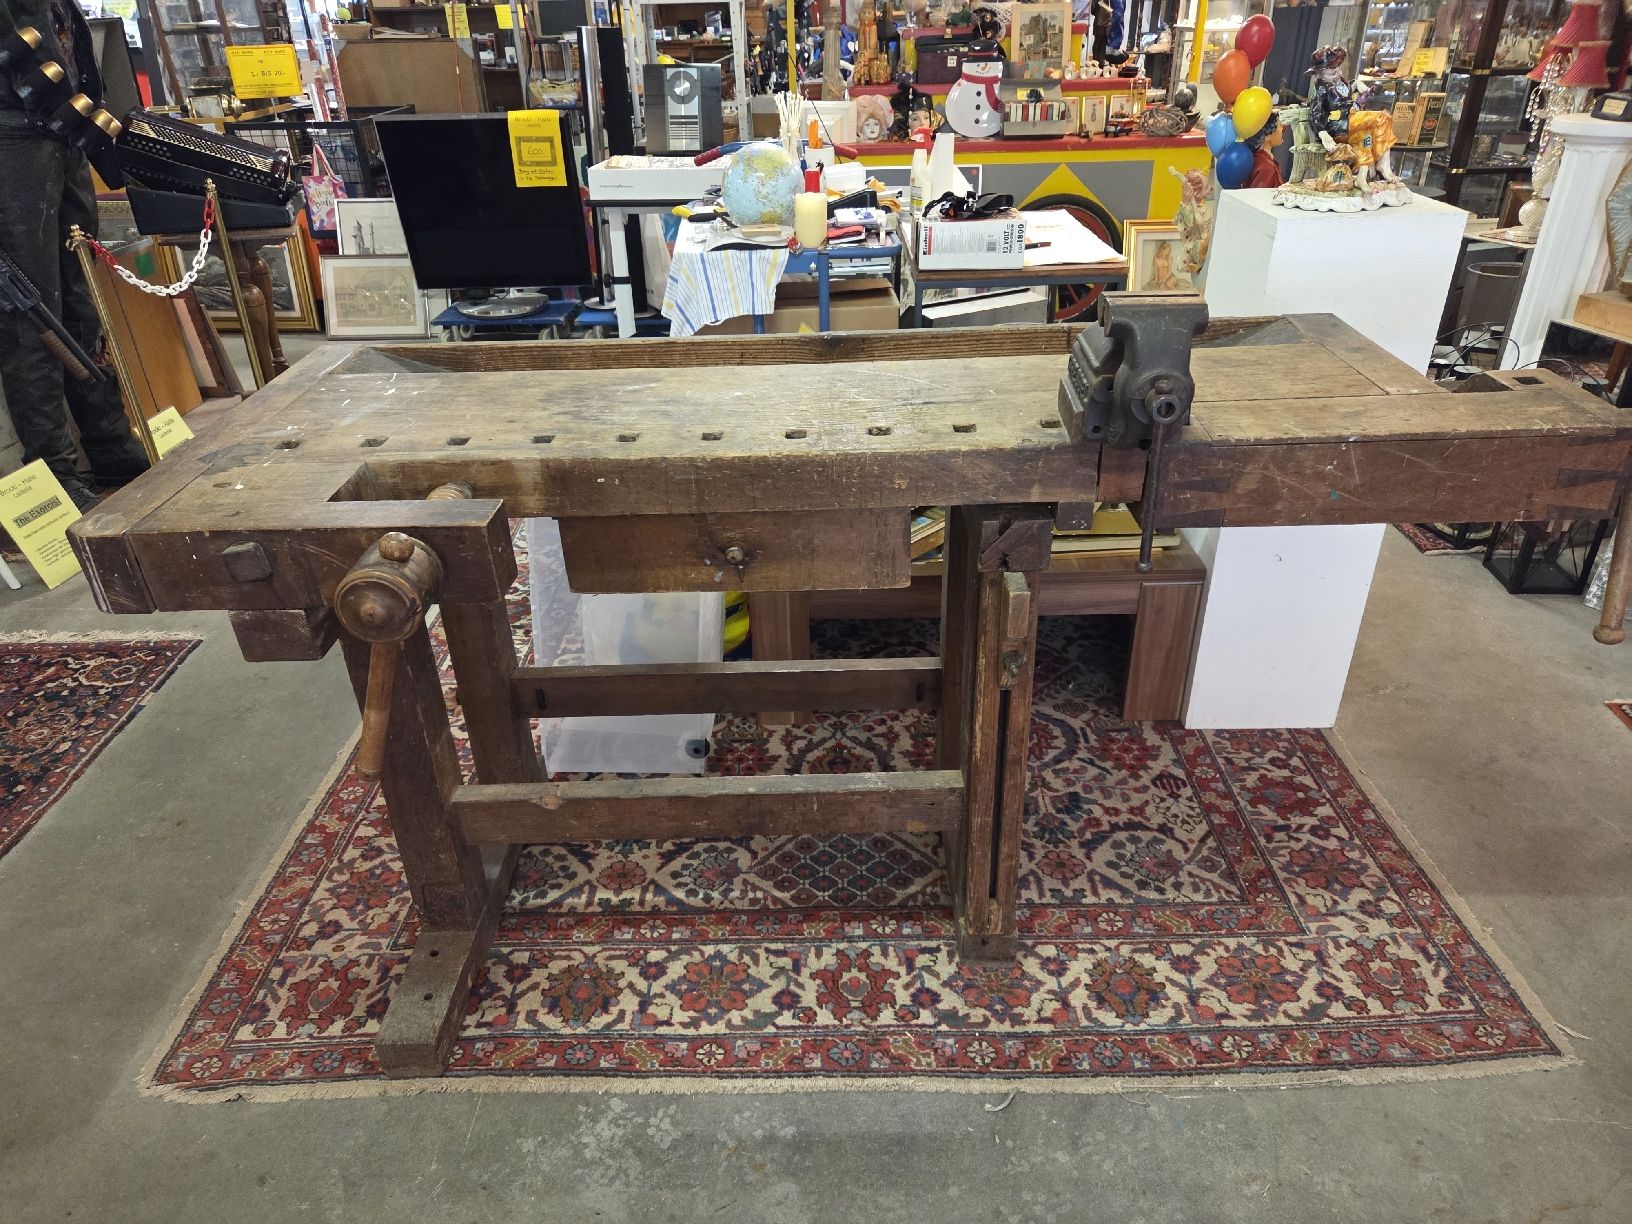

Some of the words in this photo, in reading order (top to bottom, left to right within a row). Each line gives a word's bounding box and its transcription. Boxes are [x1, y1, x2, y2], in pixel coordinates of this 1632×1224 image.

[1002, 246, 1009, 254] 12
[13, 515, 30, 528] The
[28, 496, 61, 519] Exorcist
